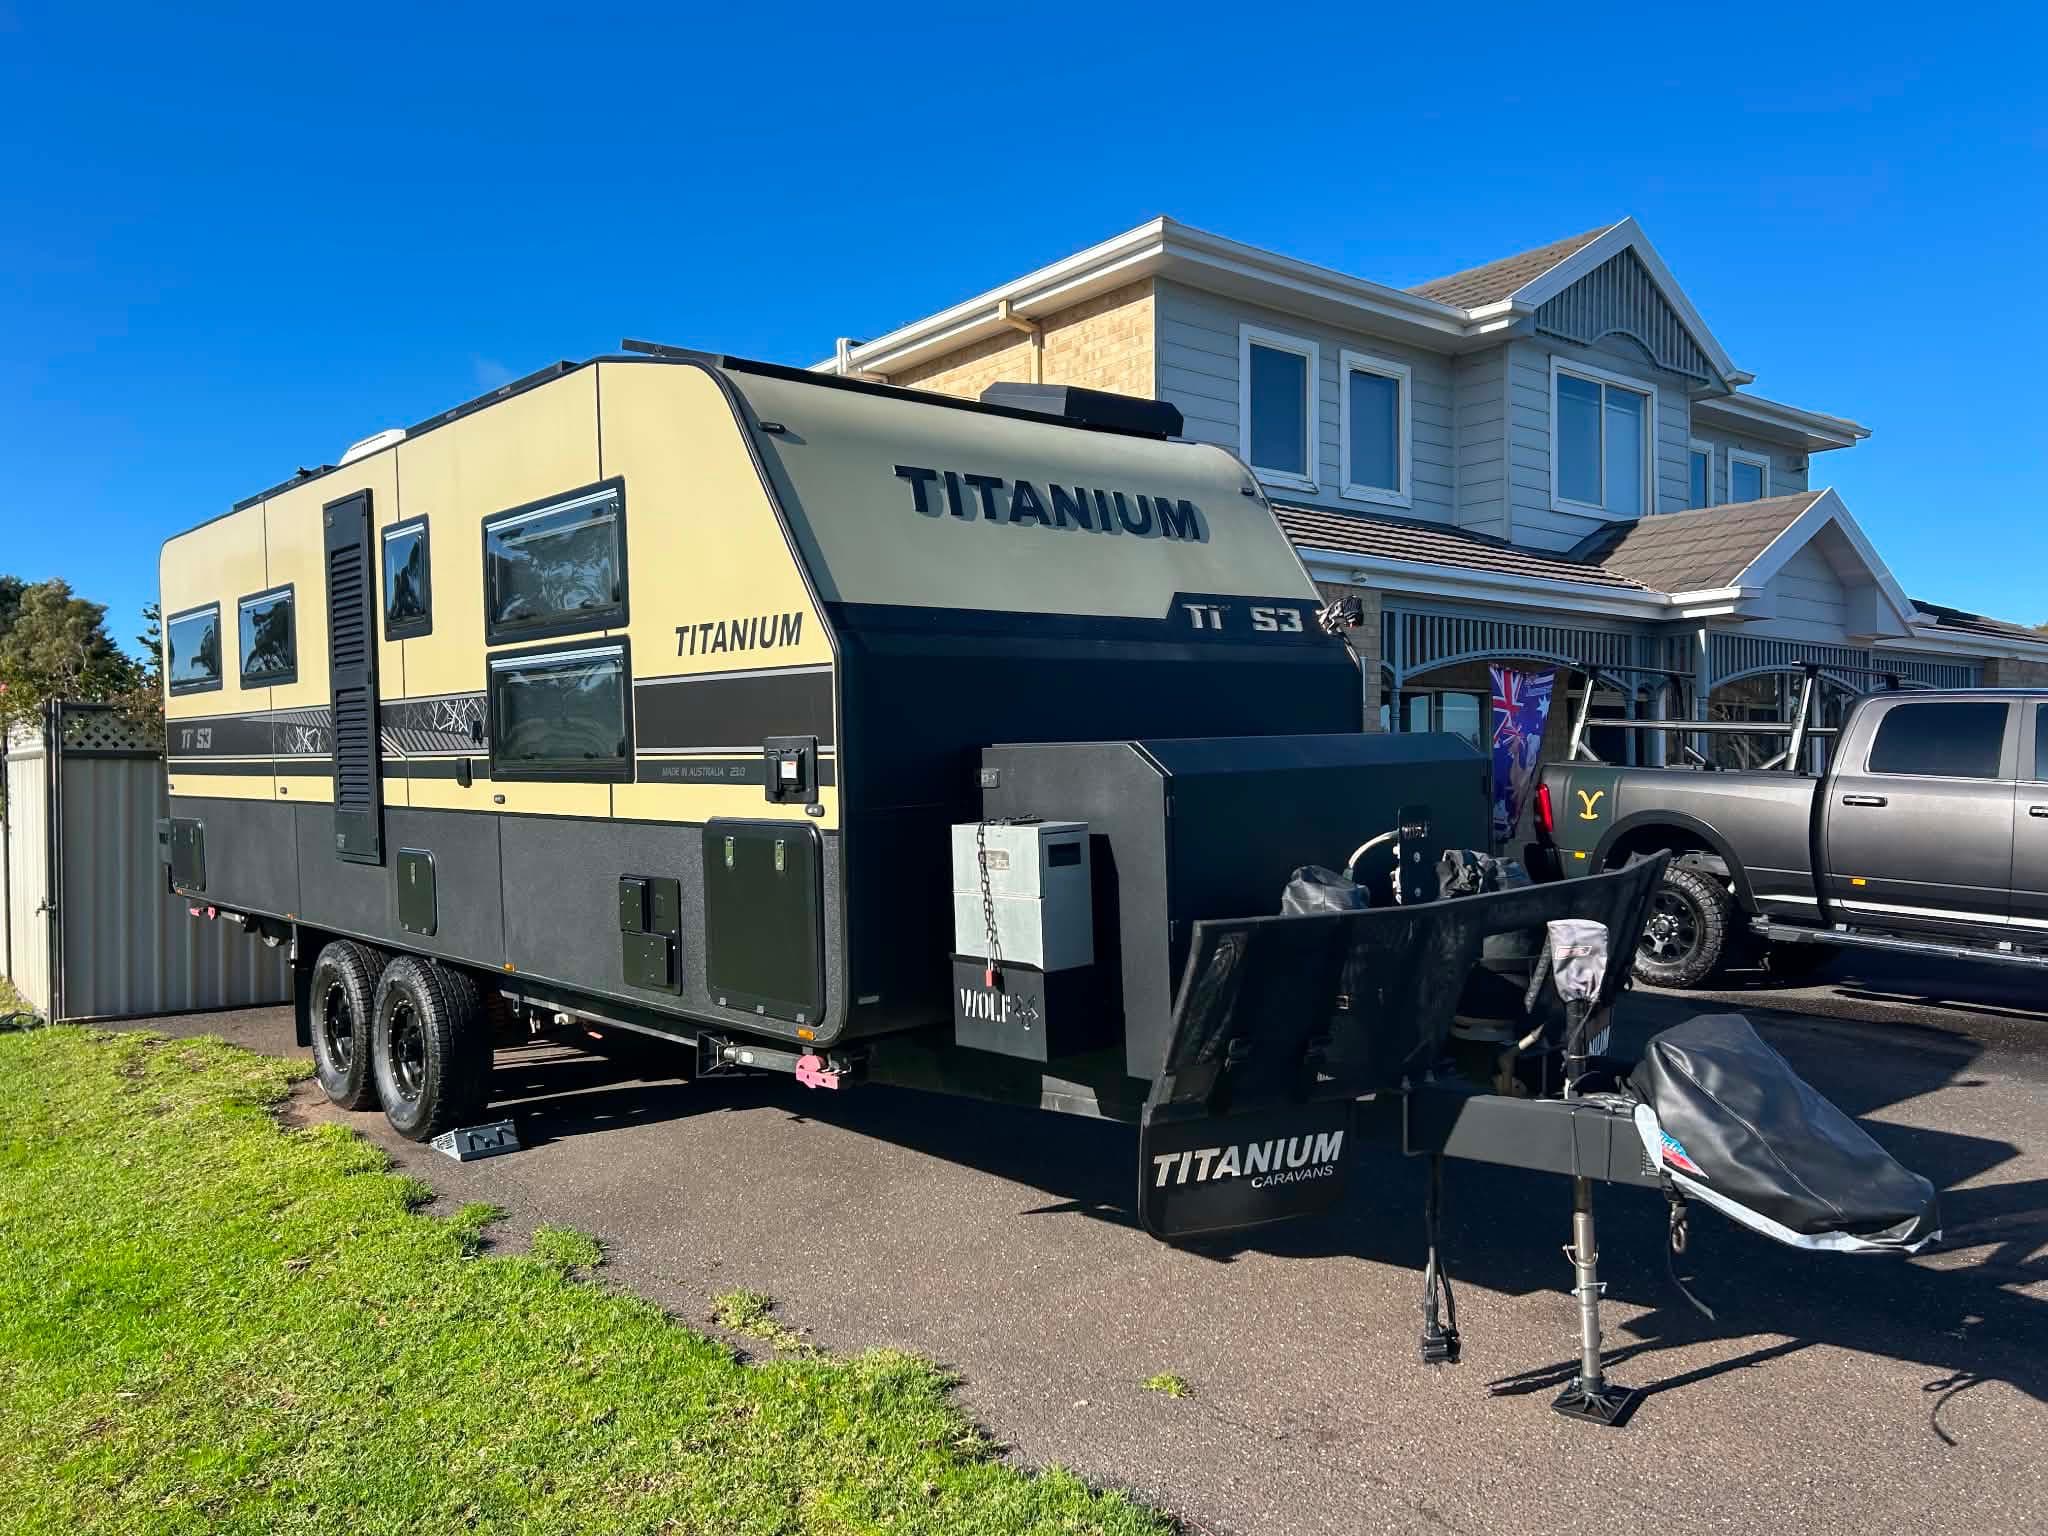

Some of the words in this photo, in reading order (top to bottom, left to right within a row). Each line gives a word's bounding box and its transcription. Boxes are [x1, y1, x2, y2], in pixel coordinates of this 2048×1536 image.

[893, 465, 1202, 540] TITANIUM
[675, 611, 803, 657] TITANIUM
[1250, 606, 1304, 632] S3
[661, 767, 680, 777] MADE
[688, 767, 724, 777] AUSTRALIA
[960, 988, 1011, 1023] WOLF
[1153, 1130, 1345, 1188] TITANIUM
[1251, 1164, 1335, 1188] CARAVANS
